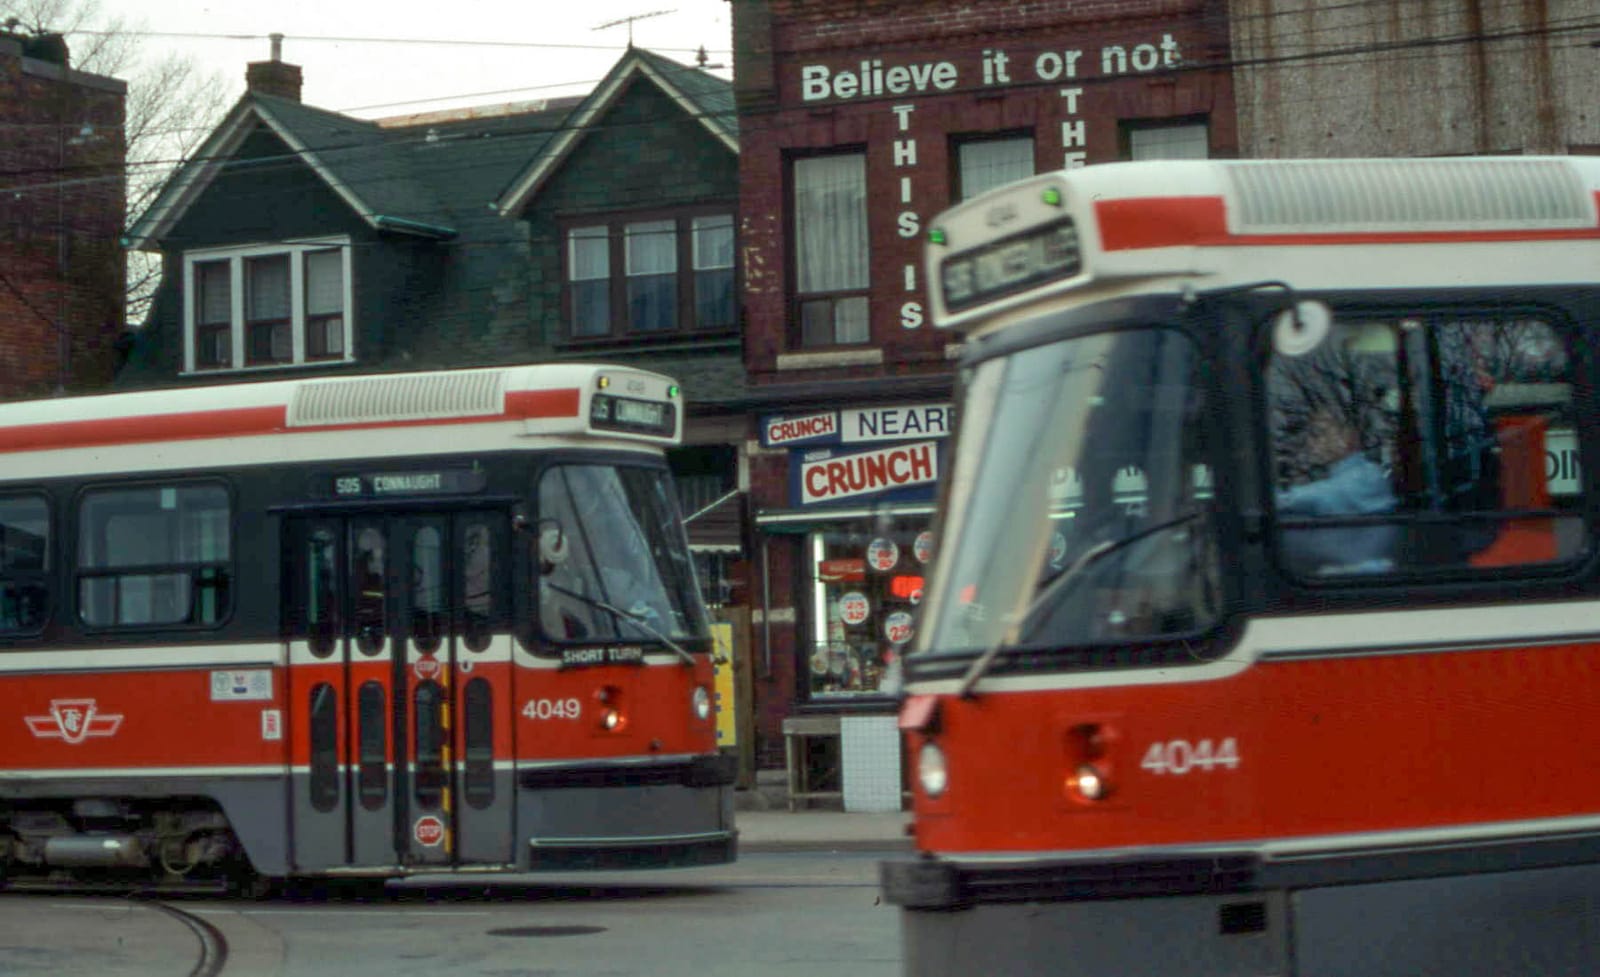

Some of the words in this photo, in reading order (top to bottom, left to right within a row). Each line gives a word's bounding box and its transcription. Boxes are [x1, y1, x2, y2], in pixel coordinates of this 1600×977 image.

[802, 58, 958, 102] Believe
[982, 49, 1011, 85] it
[1036, 49, 1083, 79] or
[1101, 33, 1179, 76] not
[892, 104, 920, 239] THIS
[902, 264, 924, 330] IS
[769, 415, 834, 442] CRUNCH
[336, 477, 361, 494] 505
[373, 473, 442, 492] CONNAUGHT
[805, 445, 932, 498] CRUNCH
[563, 648, 604, 664] SHORT
[521, 697, 581, 720] 4049
[1140, 736, 1240, 775] 4044
